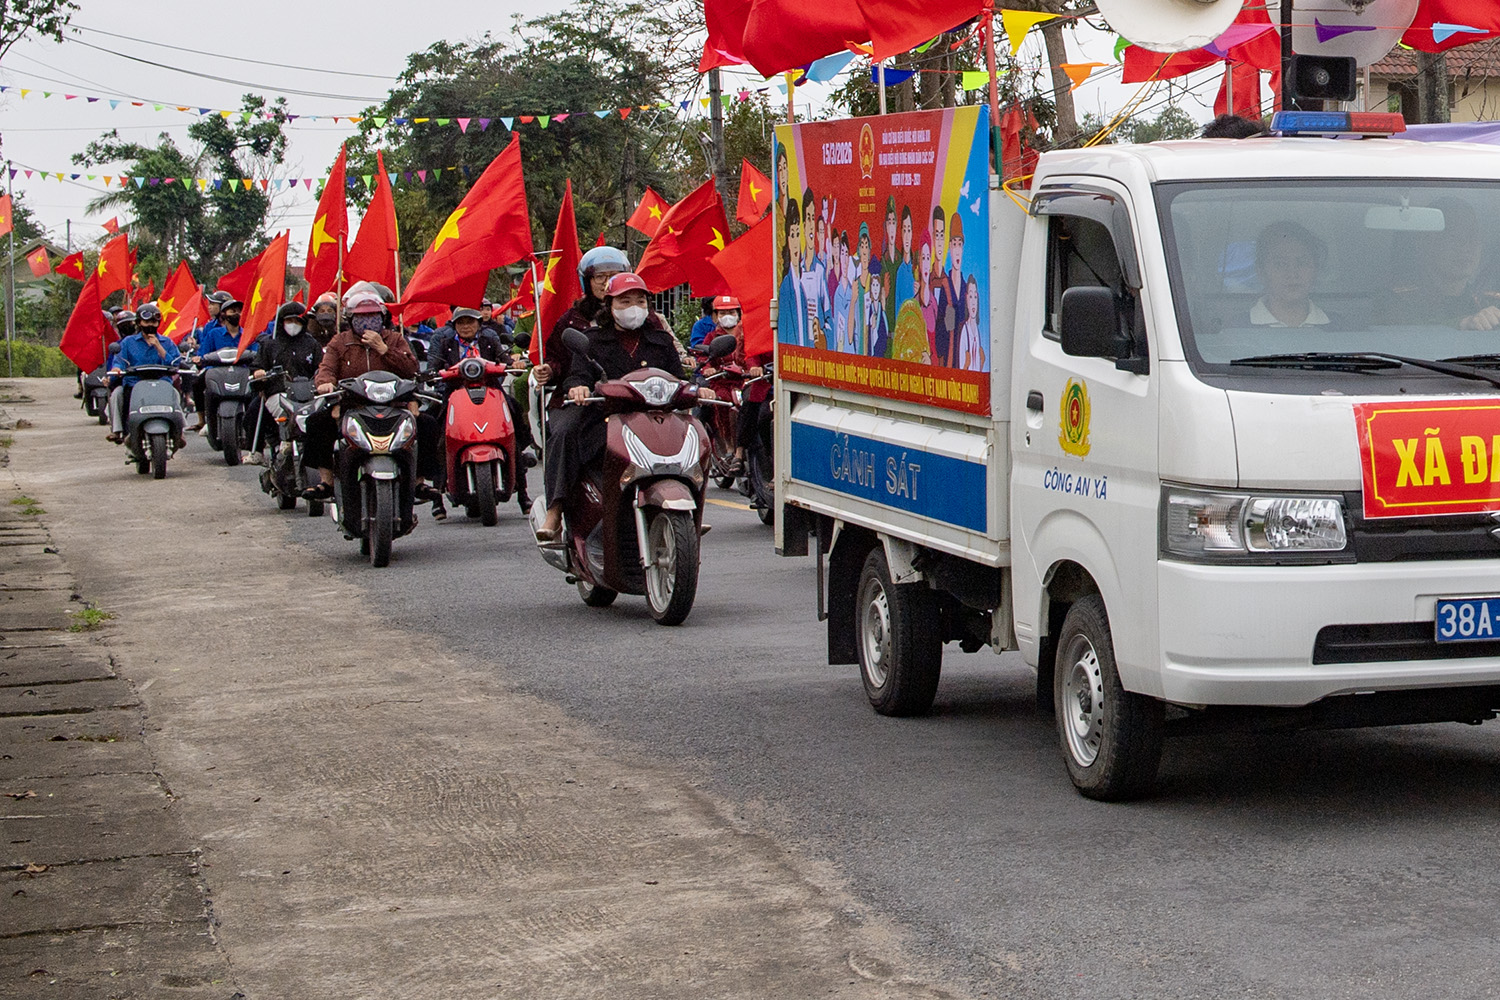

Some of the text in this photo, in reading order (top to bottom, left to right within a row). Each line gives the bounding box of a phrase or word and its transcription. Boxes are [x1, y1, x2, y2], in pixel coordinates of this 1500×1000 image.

[822, 142, 853, 165] 15/3/2026
[830, 434, 921, 500] CẢNH SÁT
[1392, 428, 1451, 488] XÃ
[1043, 466, 1108, 500] CÔNG AN XÃ
